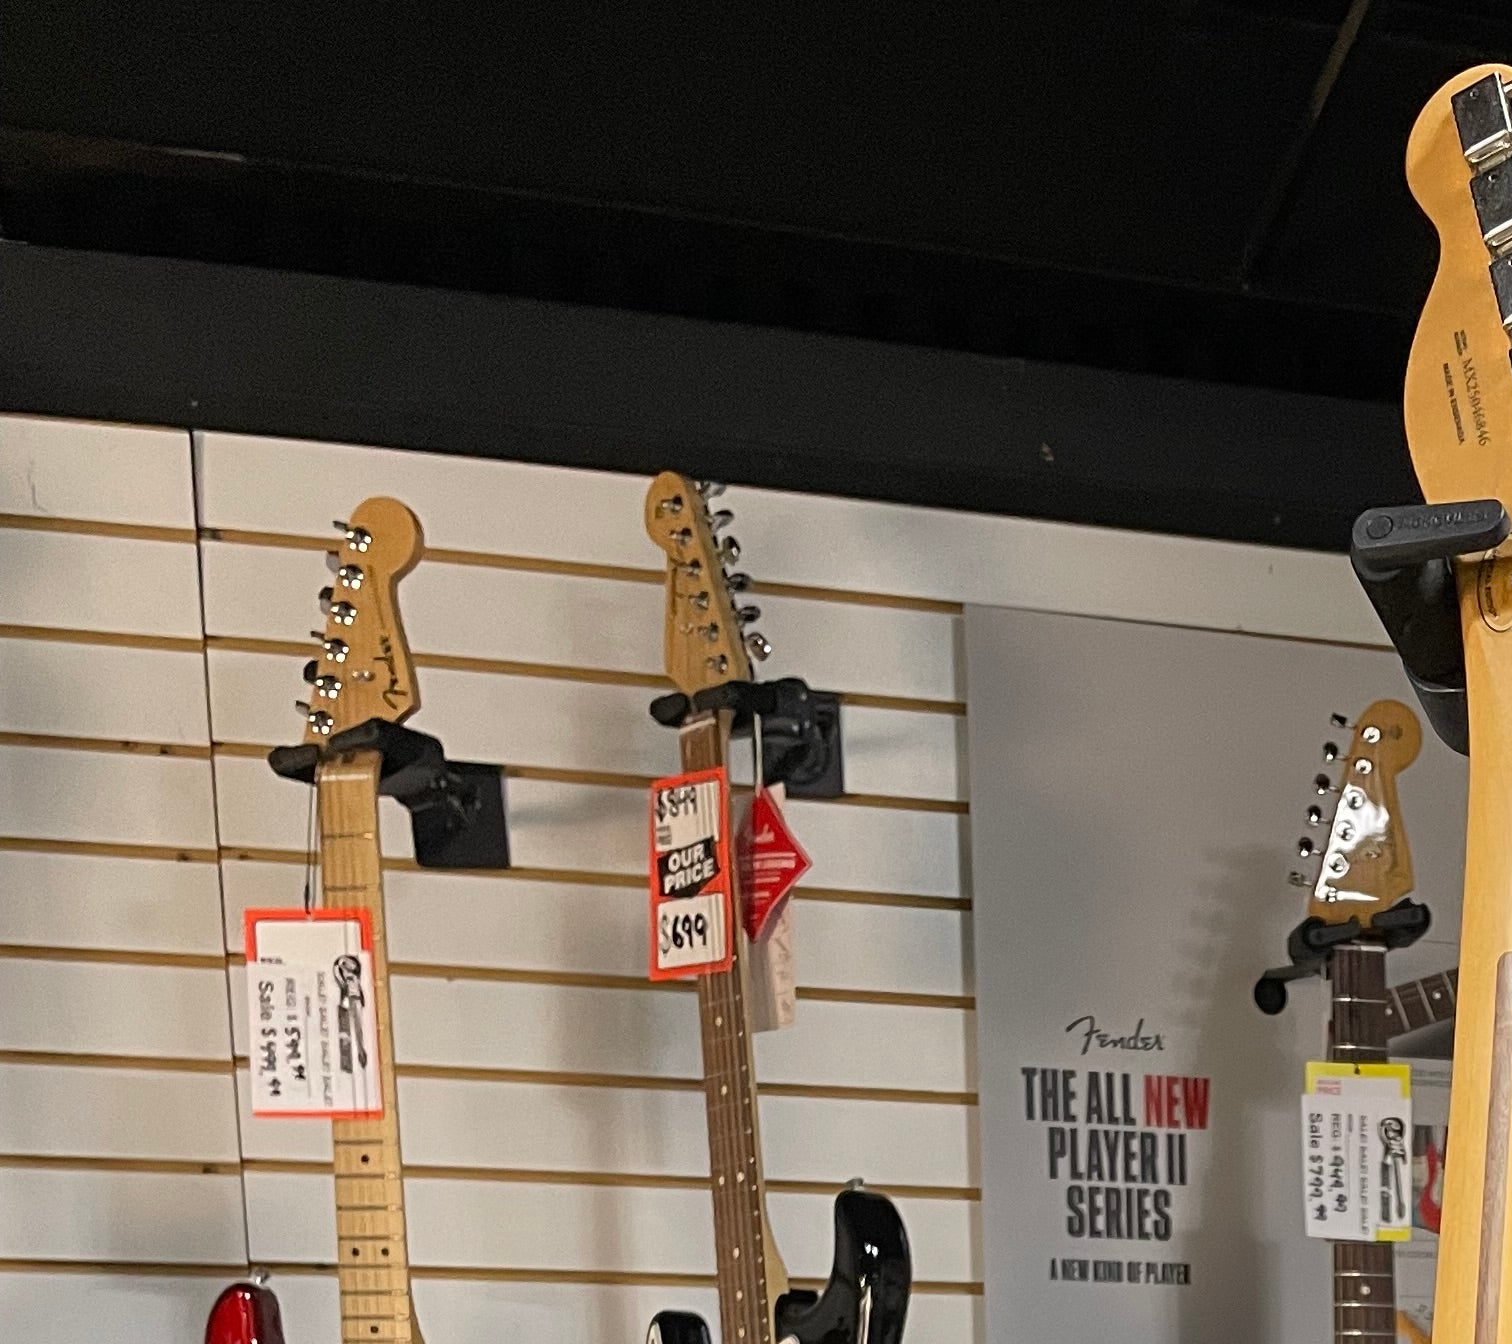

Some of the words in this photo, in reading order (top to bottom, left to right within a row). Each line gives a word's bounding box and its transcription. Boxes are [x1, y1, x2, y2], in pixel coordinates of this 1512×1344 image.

[663, 858, 715, 895] PRICE
[667, 842, 705, 873] OUR
[660, 913, 709, 957] $699
[1066, 1015, 1165, 1055] Fender
[1020, 1067, 1077, 1123] THE
[1086, 1070, 1137, 1127] ALL
[1144, 1074, 1210, 1130] NEW
[1309, 1113, 1323, 1149] Sale
[1048, 1126, 1161, 1184] PLAYER
[1167, 1132, 1188, 1186] II
[1066, 1184, 1172, 1241] SERIES
[1061, 1258, 1090, 1282] NEW
[1146, 1261, 1192, 1286] PLAYER
